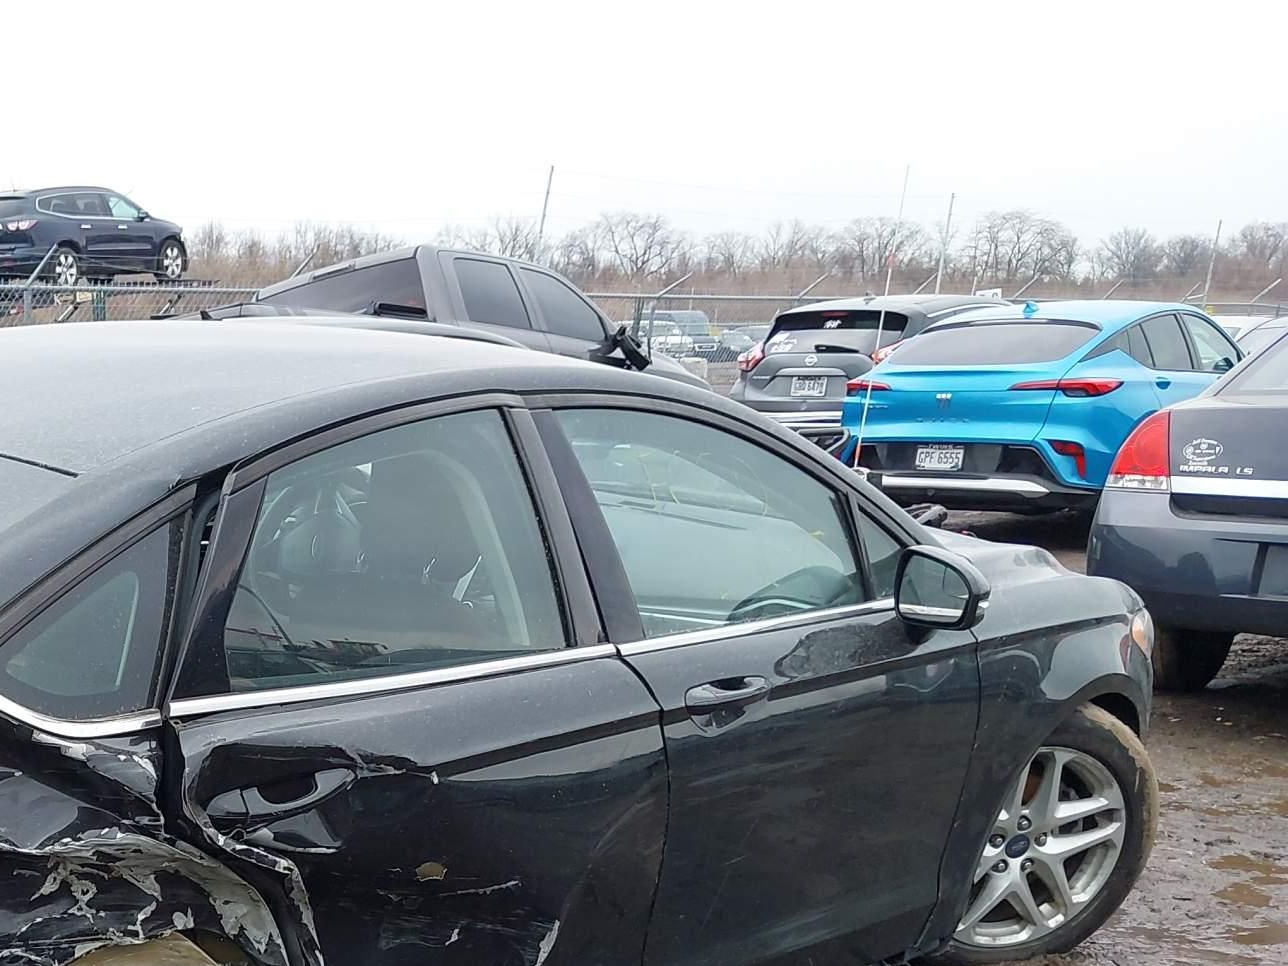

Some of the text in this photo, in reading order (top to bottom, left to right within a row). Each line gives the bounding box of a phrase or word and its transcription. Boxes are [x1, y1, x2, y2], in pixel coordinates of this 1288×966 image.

[918, 451, 961, 465] GPF 6555
[1179, 465, 1254, 475] IMPALA LS
